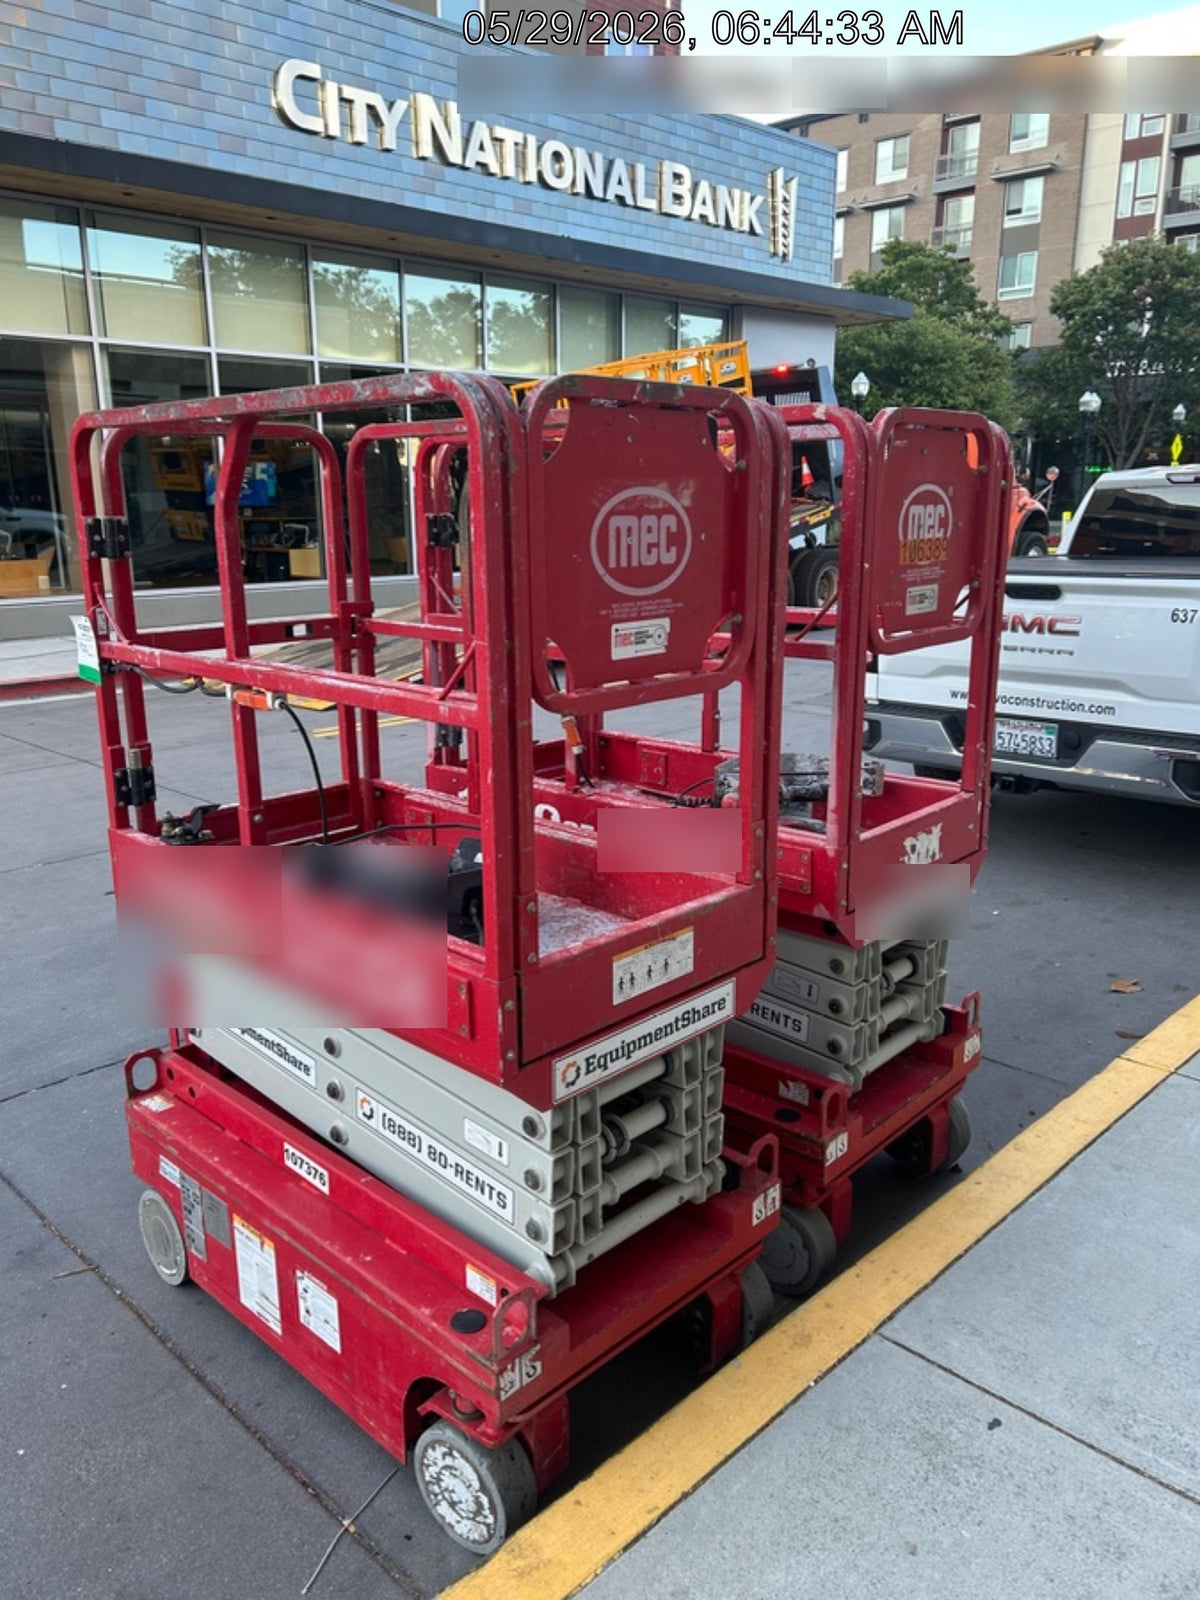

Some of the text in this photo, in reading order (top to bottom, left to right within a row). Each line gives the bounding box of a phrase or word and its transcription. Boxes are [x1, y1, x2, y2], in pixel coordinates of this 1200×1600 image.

[271, 58, 764, 237] CITY NATIONAL BANK
[1001, 612, 1082, 637] MC
[1170, 607, 1198, 624] 637
[584, 995, 728, 1076] EquipmentShare
[750, 1001, 803, 1033] RENTS
[284, 1147, 326, 1187] 107376
[382, 1112, 508, 1211] (888) 80-RENTS
